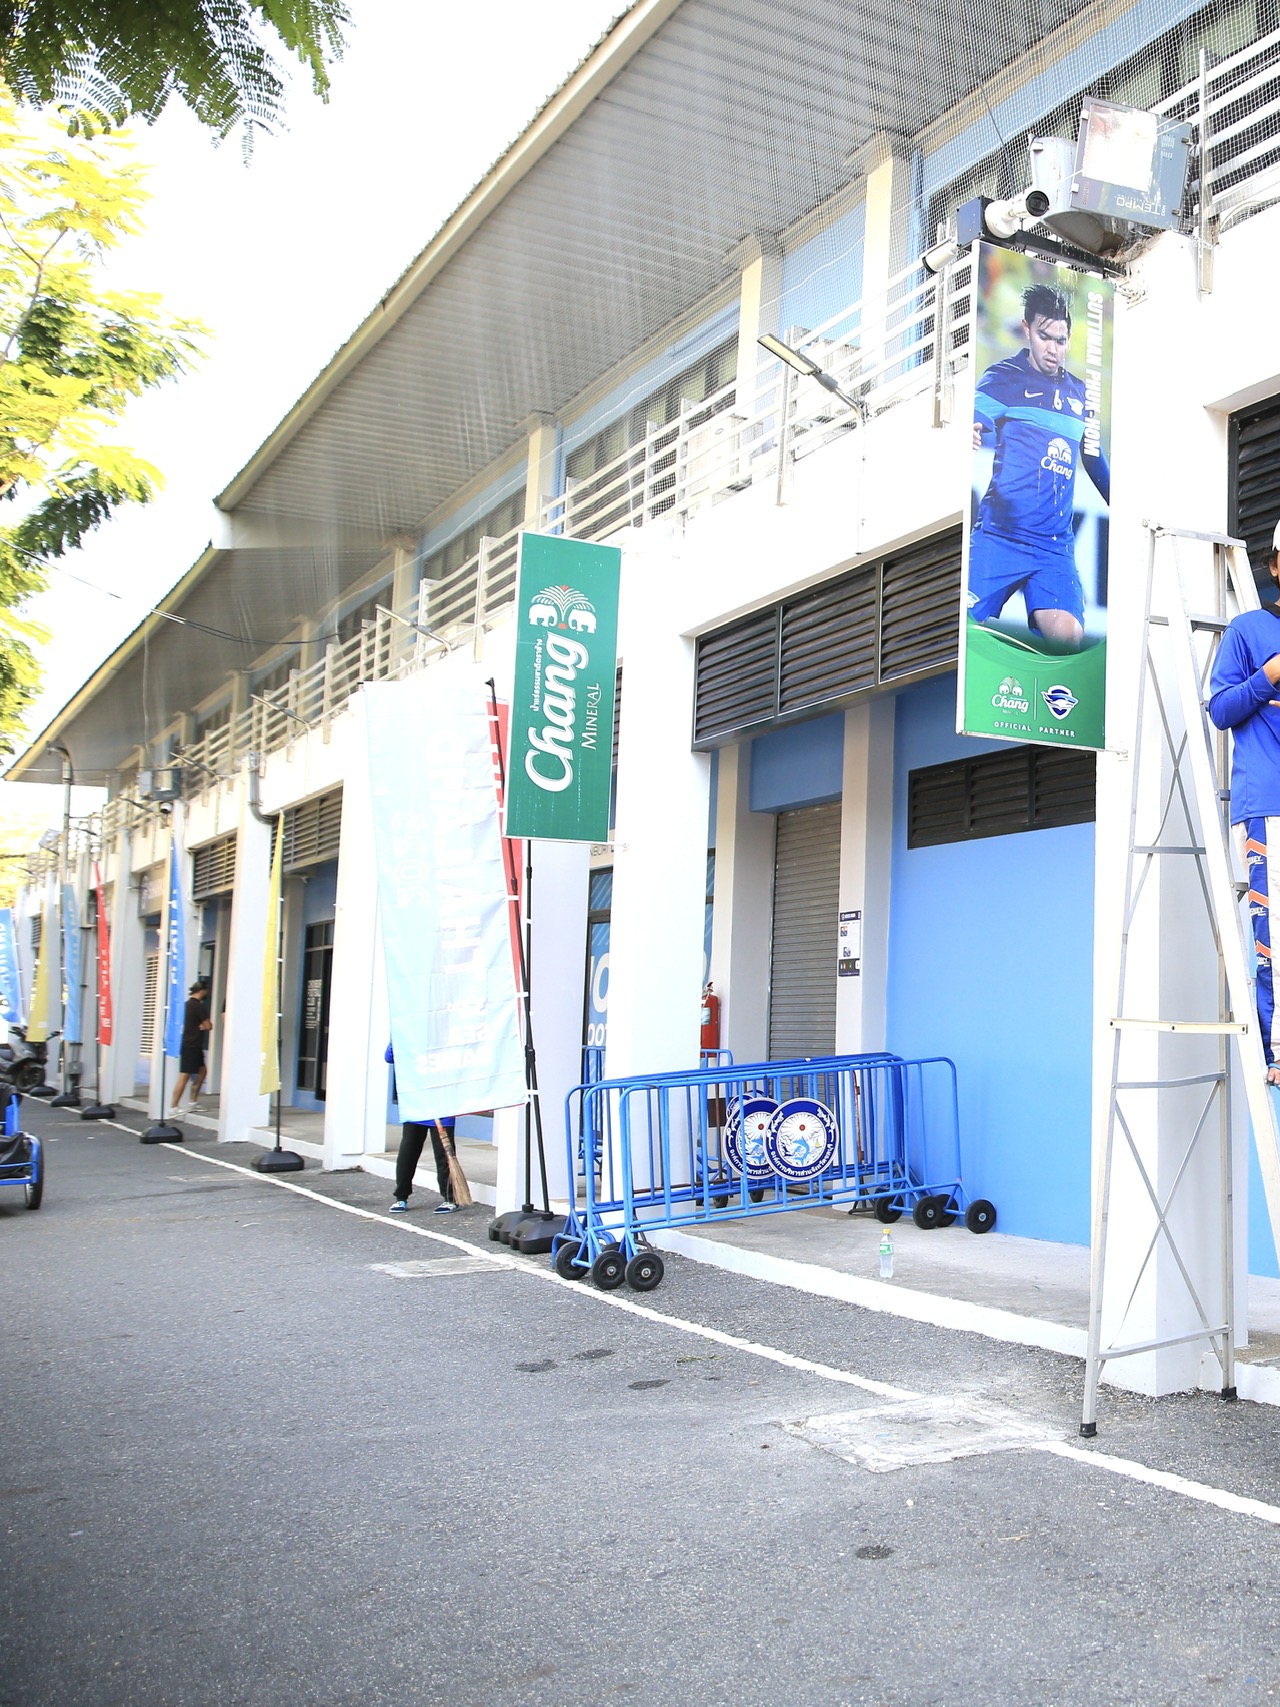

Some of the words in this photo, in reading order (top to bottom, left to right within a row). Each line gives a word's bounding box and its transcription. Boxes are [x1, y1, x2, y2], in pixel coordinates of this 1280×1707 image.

[1115, 197, 1160, 216] TEMPO
[1084, 368, 1102, 458] PHUK-HOM
[1041, 456, 1073, 480] Chang
[524, 631, 590, 793] Chang
[991, 694, 1030, 713] Chang
[581, 682, 602, 750] MINERAL
[994, 721, 1032, 732] OFFICIAL
[1039, 726, 1076, 738] PARTNER
